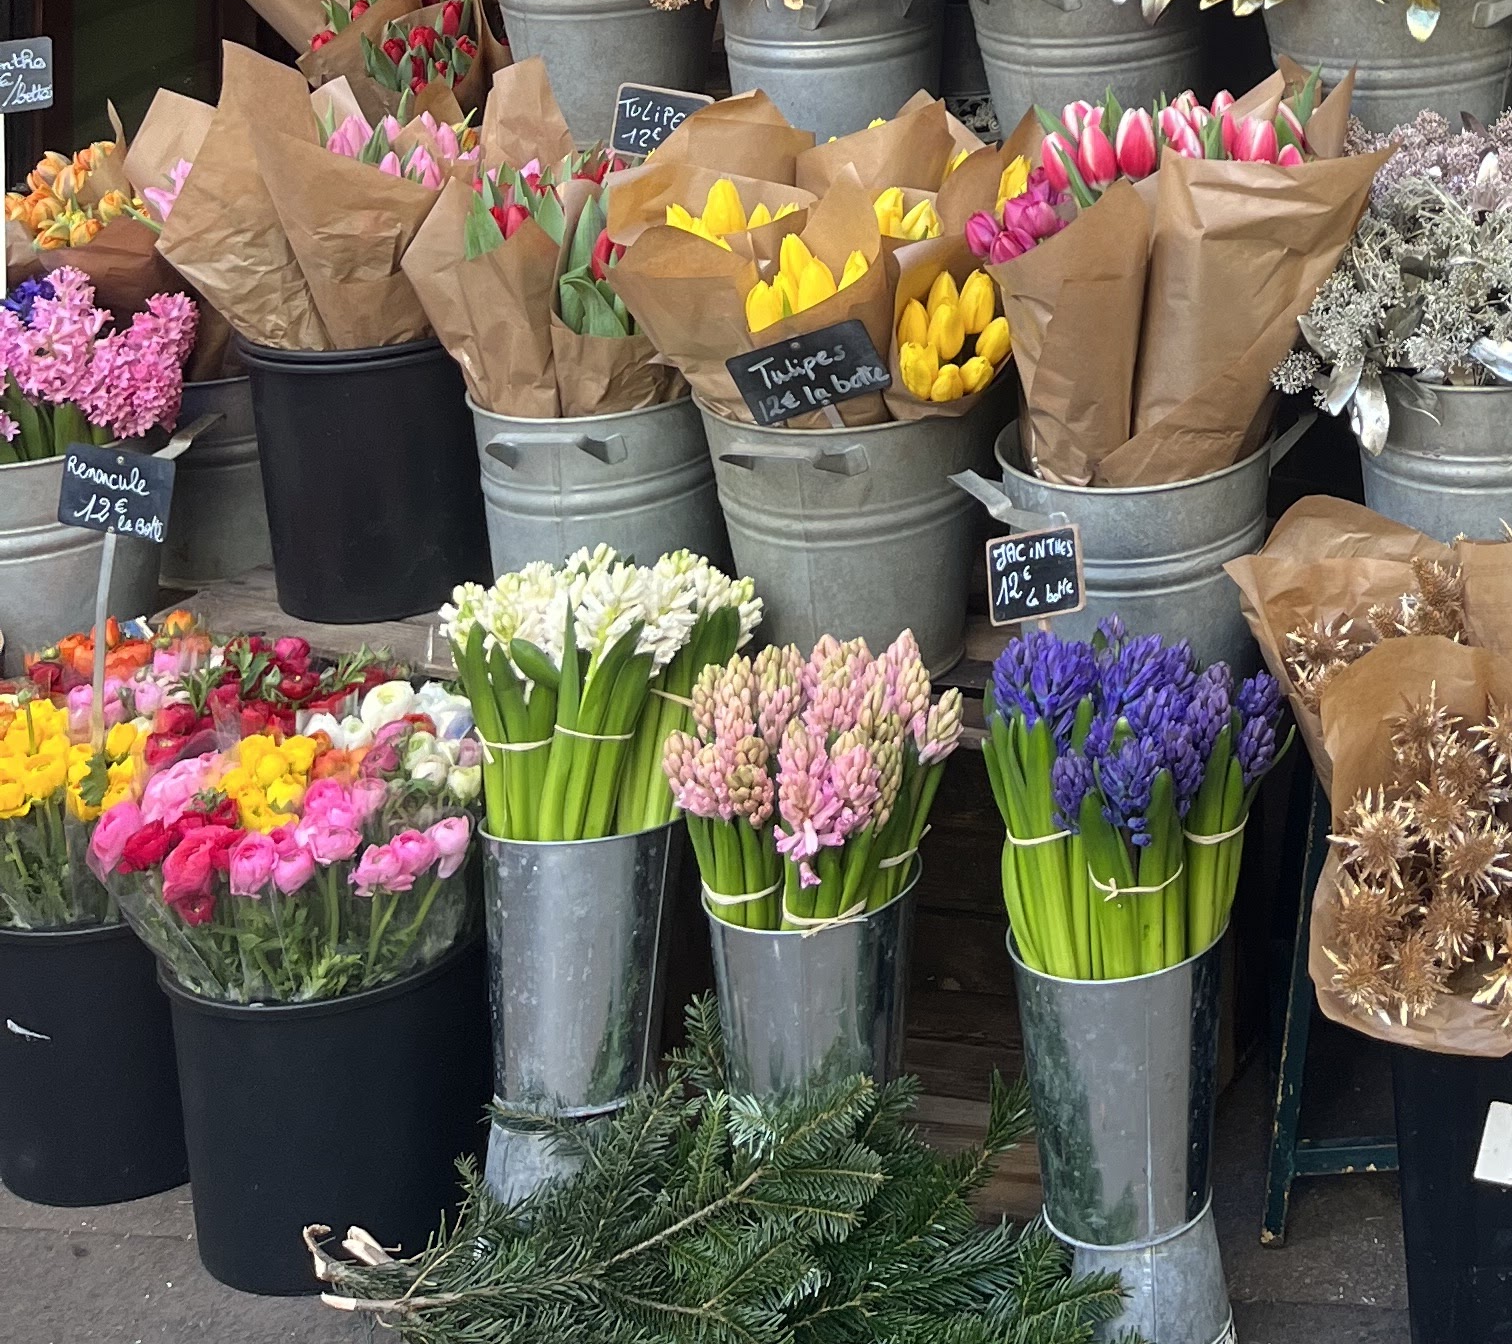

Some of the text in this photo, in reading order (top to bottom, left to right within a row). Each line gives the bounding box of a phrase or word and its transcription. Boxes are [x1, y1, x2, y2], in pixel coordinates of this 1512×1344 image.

[747, 344, 847, 390] Tulipes
[758, 365, 891, 423] 12€ la botte
